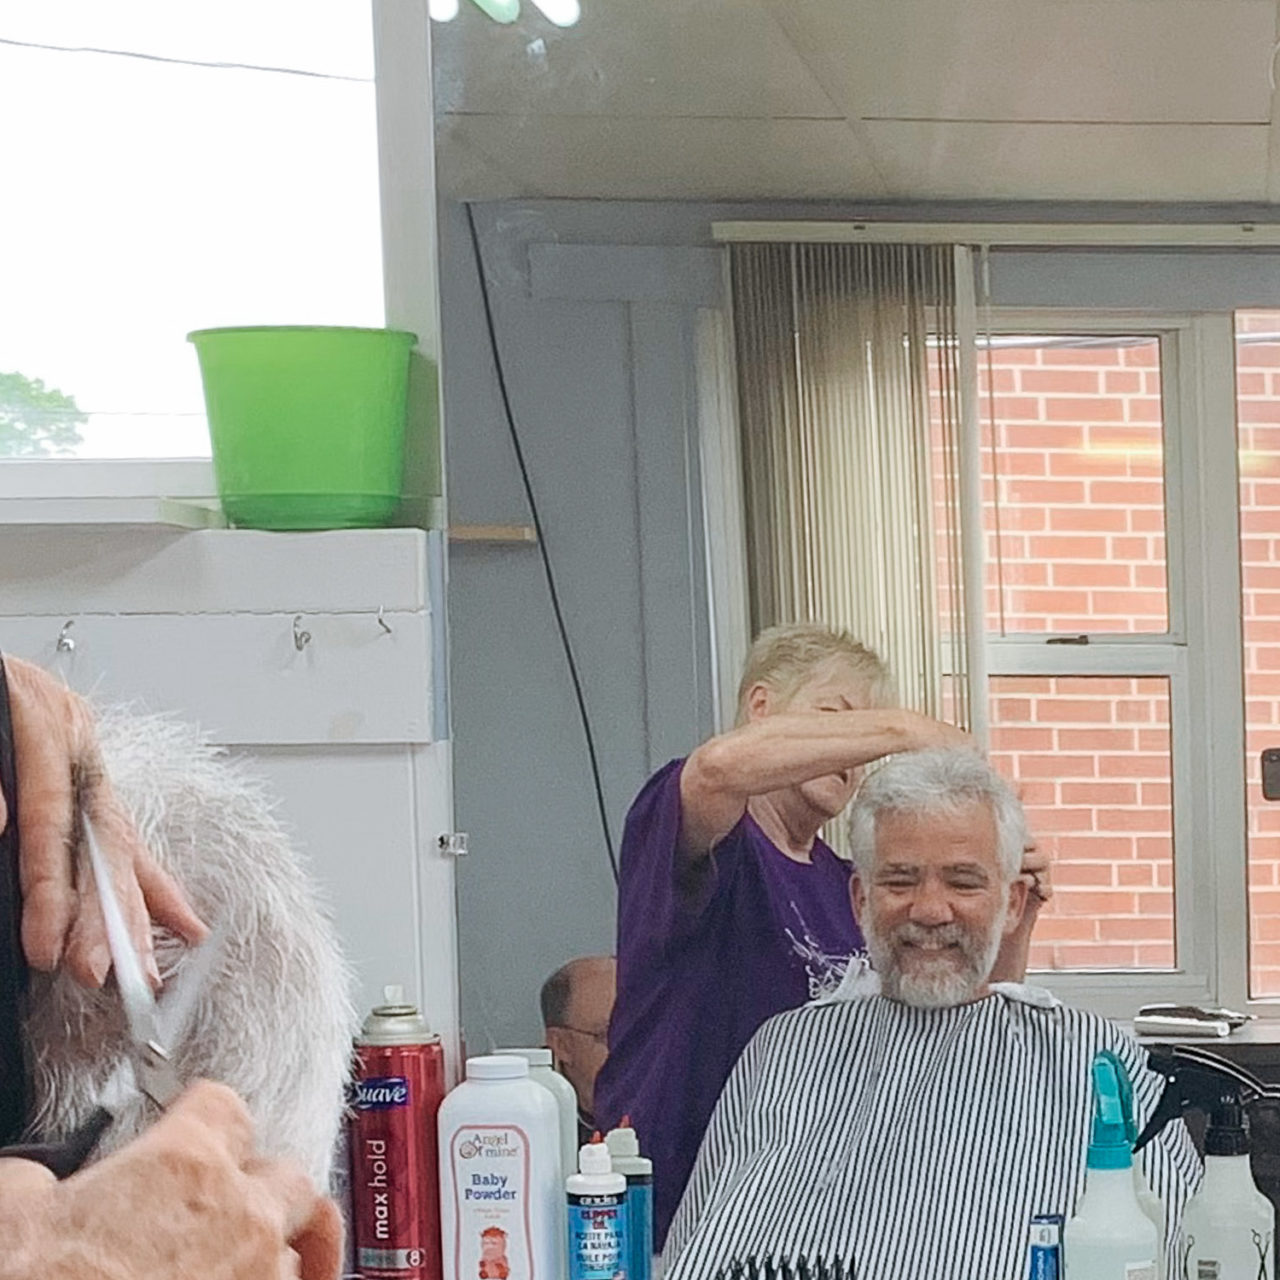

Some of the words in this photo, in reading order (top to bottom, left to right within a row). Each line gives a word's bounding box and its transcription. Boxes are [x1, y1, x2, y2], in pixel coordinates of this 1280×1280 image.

[367, 1139, 386, 1187] hold
[465, 1188, 517, 1200] Powder
[471, 1173, 508, 1188] Baby
[375, 1193, 389, 1239] max
